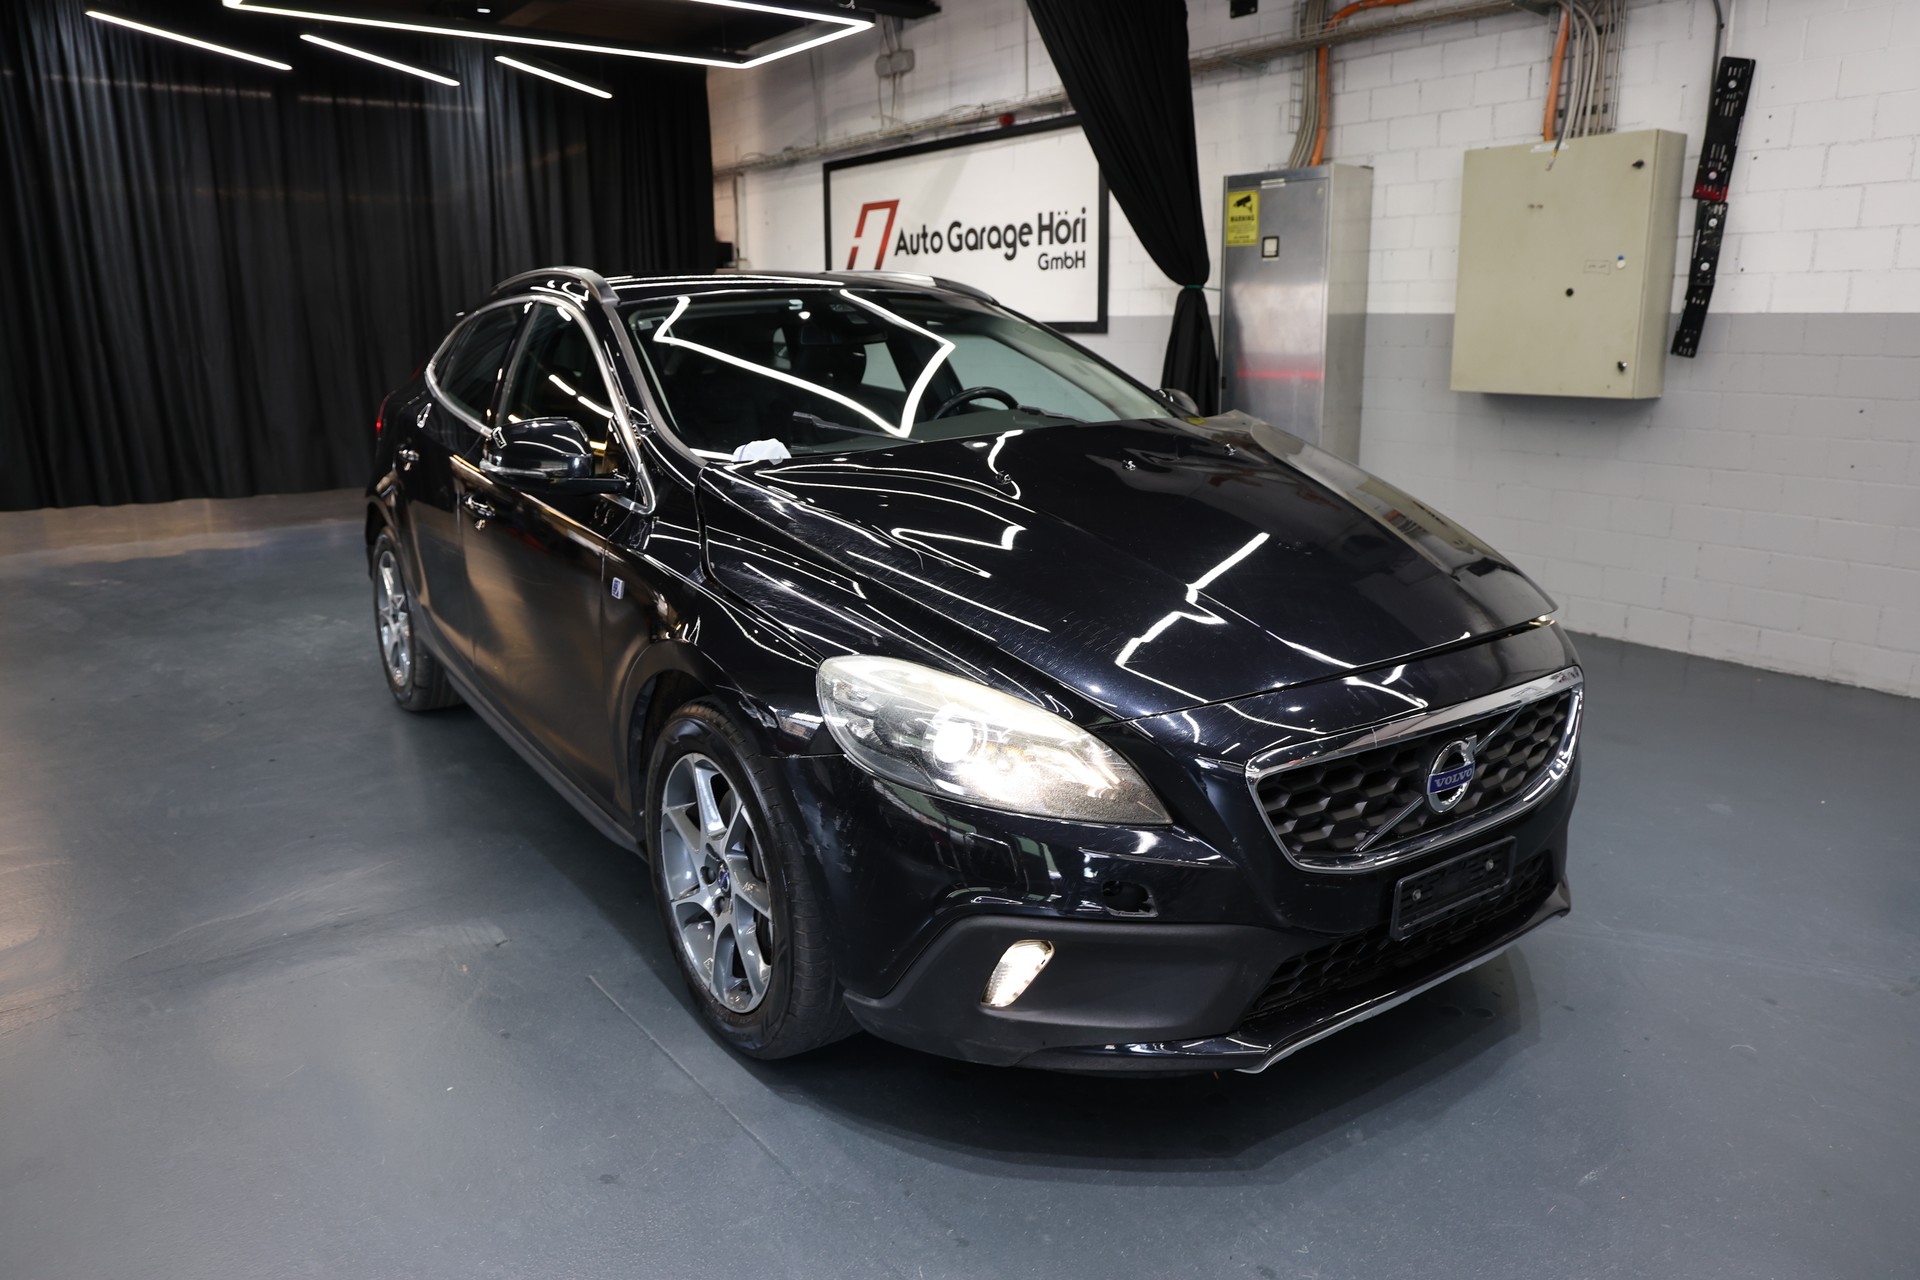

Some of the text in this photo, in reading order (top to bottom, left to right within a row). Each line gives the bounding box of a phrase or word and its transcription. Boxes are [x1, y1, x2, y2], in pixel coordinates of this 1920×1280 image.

[894, 207, 1086, 261] Auto Garage Höri
[1038, 250, 1086, 271] GmbH
[1434, 767, 1473, 788] VOLVO
